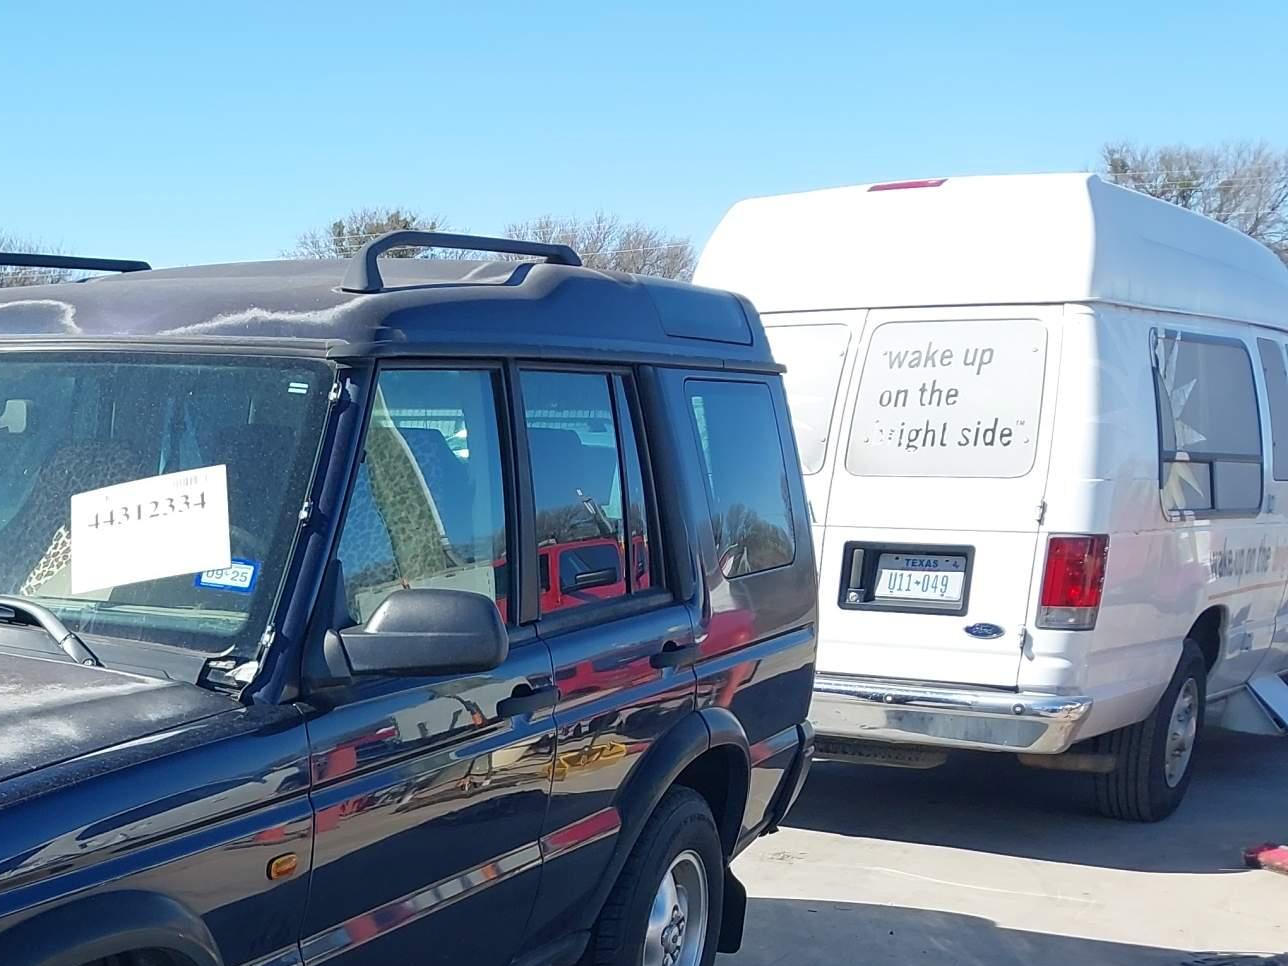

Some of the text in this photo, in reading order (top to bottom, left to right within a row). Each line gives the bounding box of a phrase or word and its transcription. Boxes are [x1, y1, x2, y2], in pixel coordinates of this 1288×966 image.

[963, 347, 995, 375] up
[879, 379, 959, 407] on the
[88, 491, 207, 529] 44312334
[904, 558, 939, 569] TEXAS
